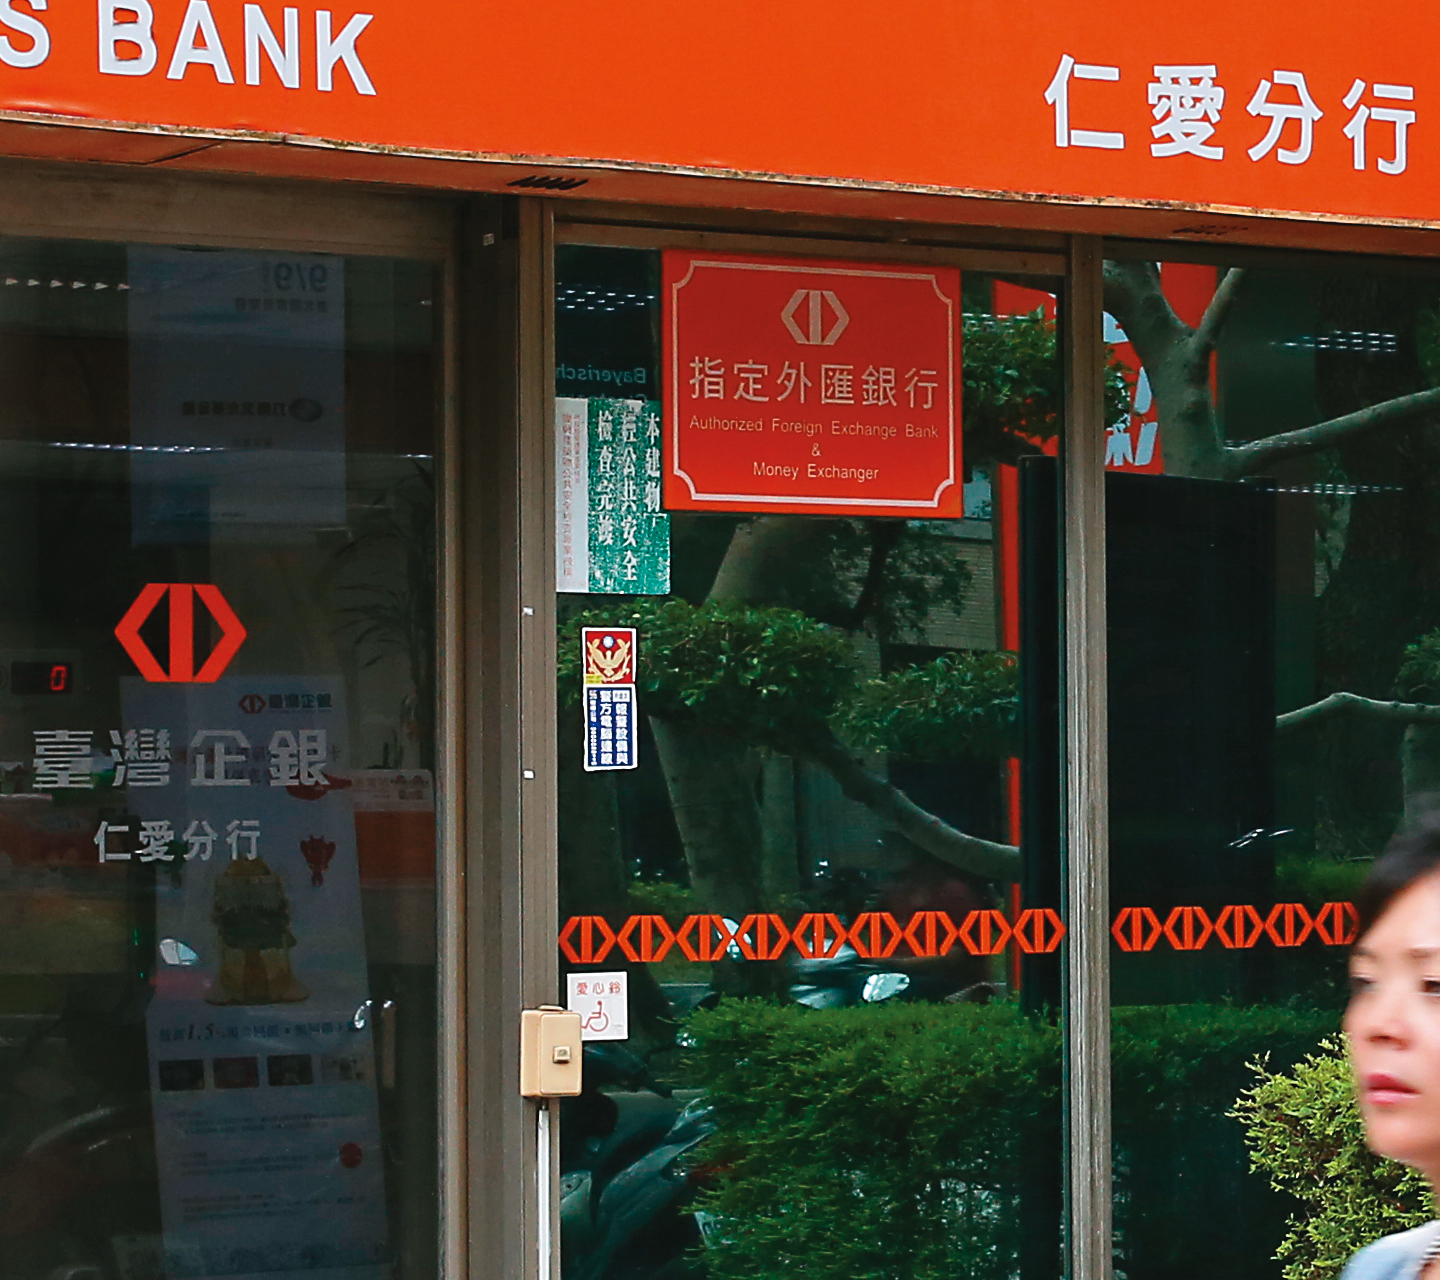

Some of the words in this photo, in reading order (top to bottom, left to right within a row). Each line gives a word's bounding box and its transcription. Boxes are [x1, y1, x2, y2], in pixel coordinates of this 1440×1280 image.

[1044, 54, 1416, 175] 仁愛分行
[689, 356, 938, 409] 指定外匯銀行
[689, 415, 763, 432] Authorized
[772, 418, 822, 436] Foreign
[831, 421, 897, 439] Exchange
[906, 424, 938, 438] Bank
[812, 443, 821, 457] &
[643, 412, 667, 527] 本建物
[753, 462, 799, 480] Money
[807, 464, 879, 482] Exchanger
[31, 728, 331, 790] 臺灣企銀
[93, 819, 261, 866] 仁愛分行
[577, 981, 621, 996] 愛心鈴
